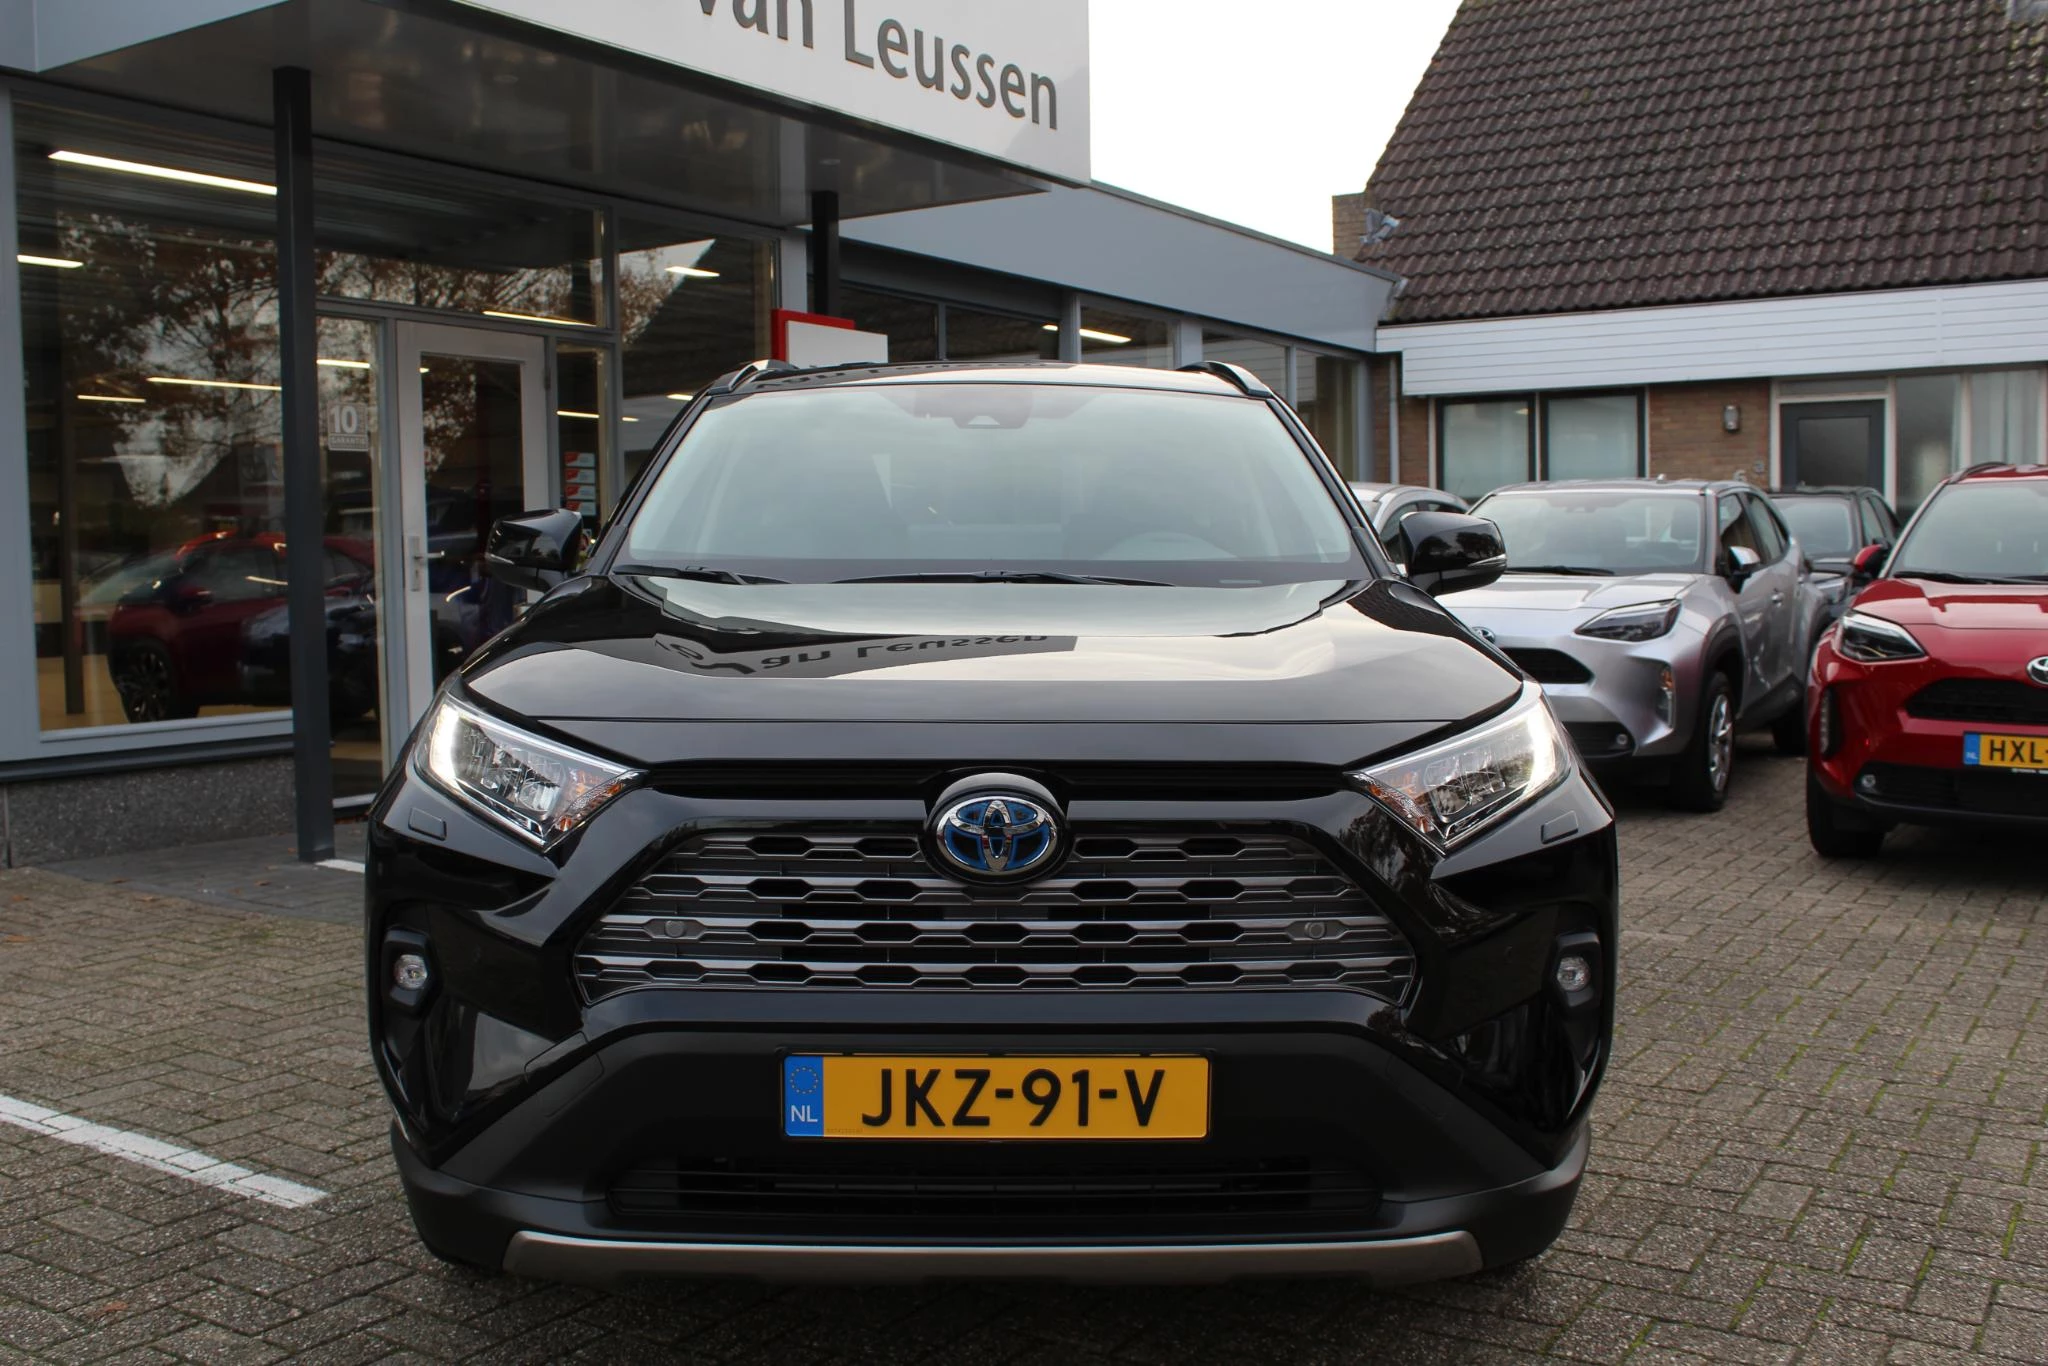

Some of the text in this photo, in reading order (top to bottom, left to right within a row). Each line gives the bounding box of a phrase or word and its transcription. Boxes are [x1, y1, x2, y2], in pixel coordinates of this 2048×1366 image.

[844, 0, 1057, 130] Leussen
[330, 405, 358, 433] 10
[791, 1104, 819, 1123] NL
[861, 1068, 1165, 1127] JKZ-91-V
